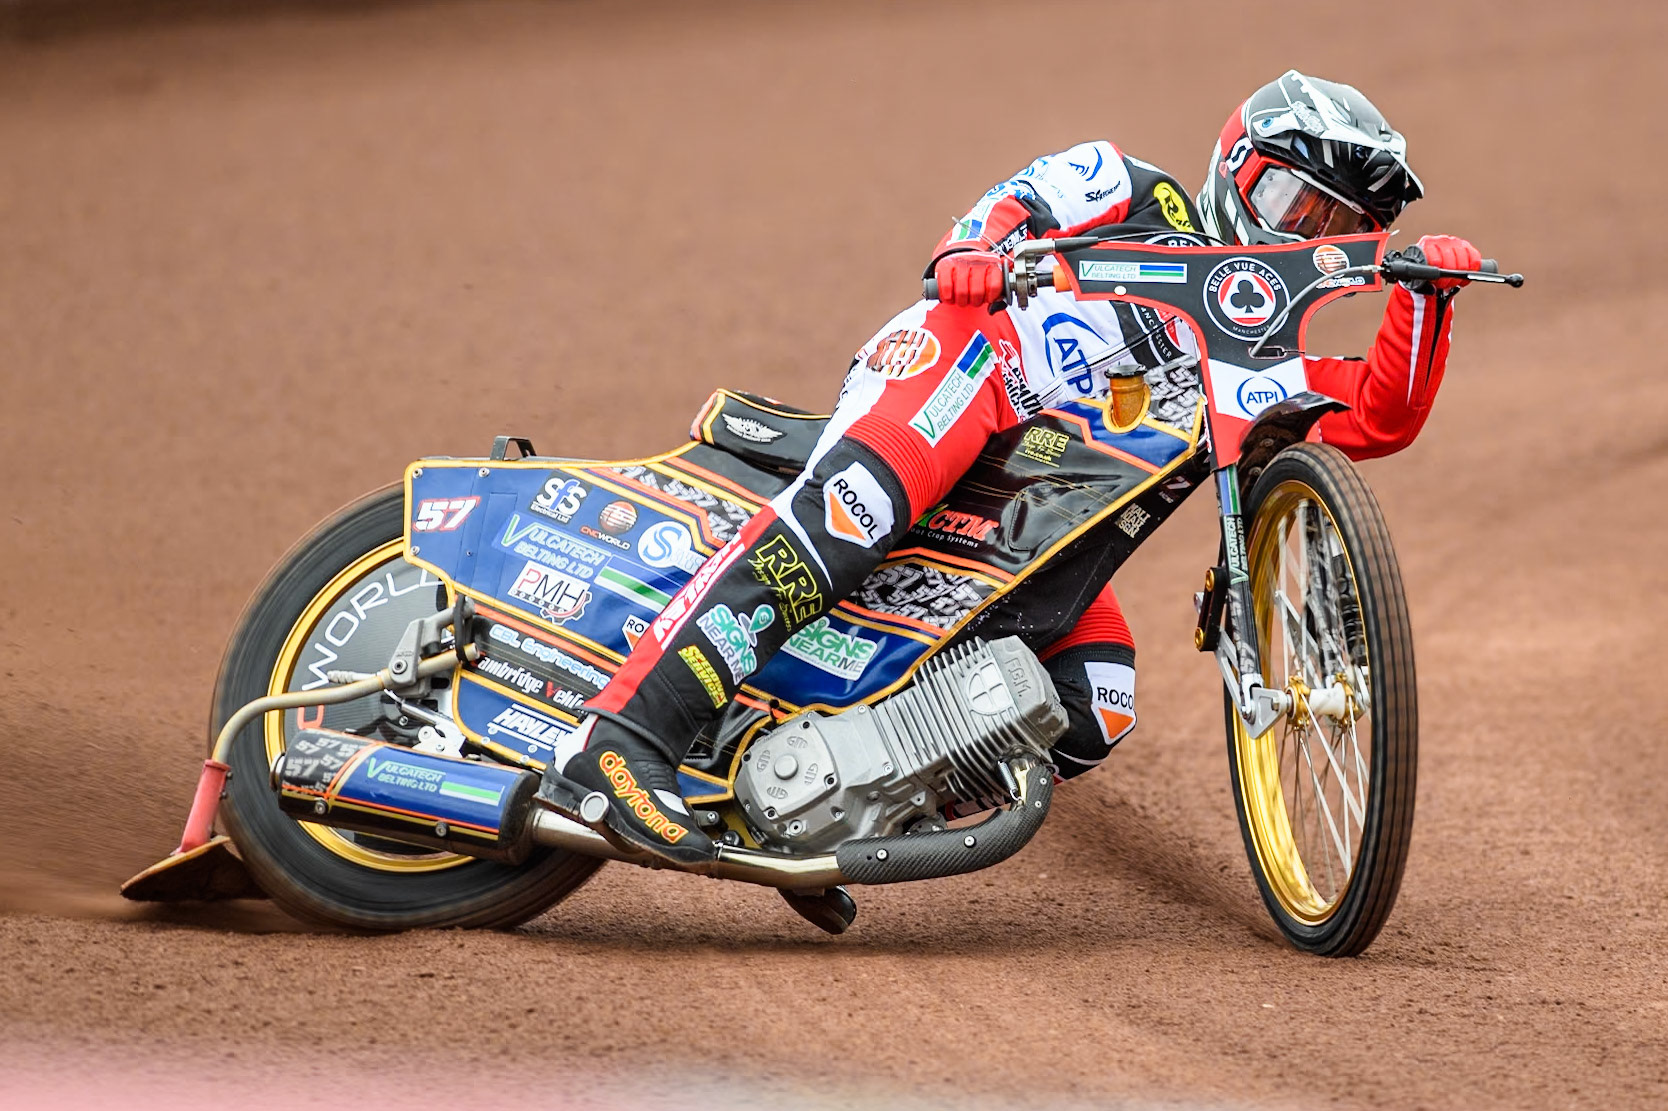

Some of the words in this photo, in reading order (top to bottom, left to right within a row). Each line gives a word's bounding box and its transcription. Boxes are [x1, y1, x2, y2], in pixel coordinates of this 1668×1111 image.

[1208, 265, 1232, 293] BELLE
[1233, 262, 1256, 271] VUE
[1259, 269, 1282, 291] ACES
[1053, 337, 1094, 395] ATP
[913, 372, 964, 439] VULCATECH
[937, 397, 964, 432] BELTING
[960, 383, 974, 400] LTD
[1246, 391, 1279, 404] ATPI
[1023, 426, 1070, 453] RRE
[412, 496, 481, 532] 57
[833, 478, 881, 540] ROCOL
[929, 509, 999, 541] CTM
[501, 514, 606, 567] VULCATECH
[580, 525, 632, 551] CNCWORLD
[946, 534, 980, 549] Systems
[513, 541, 570, 570] BELTING
[565, 561, 595, 579] LTD
[755, 534, 823, 624] RRE
[517, 568, 586, 609] PMH
[489, 624, 521, 648] CBL
[521, 638, 611, 690] Engineering
[700, 616, 735, 660] NEAR
[731, 661, 745, 683] ME
[710, 607, 756, 675] SIGNS
[1096, 686, 1134, 710] ROCO
[377, 773, 418, 789] BELTING
[418, 783, 438, 792] LTD
[599, 750, 689, 844] daytona
